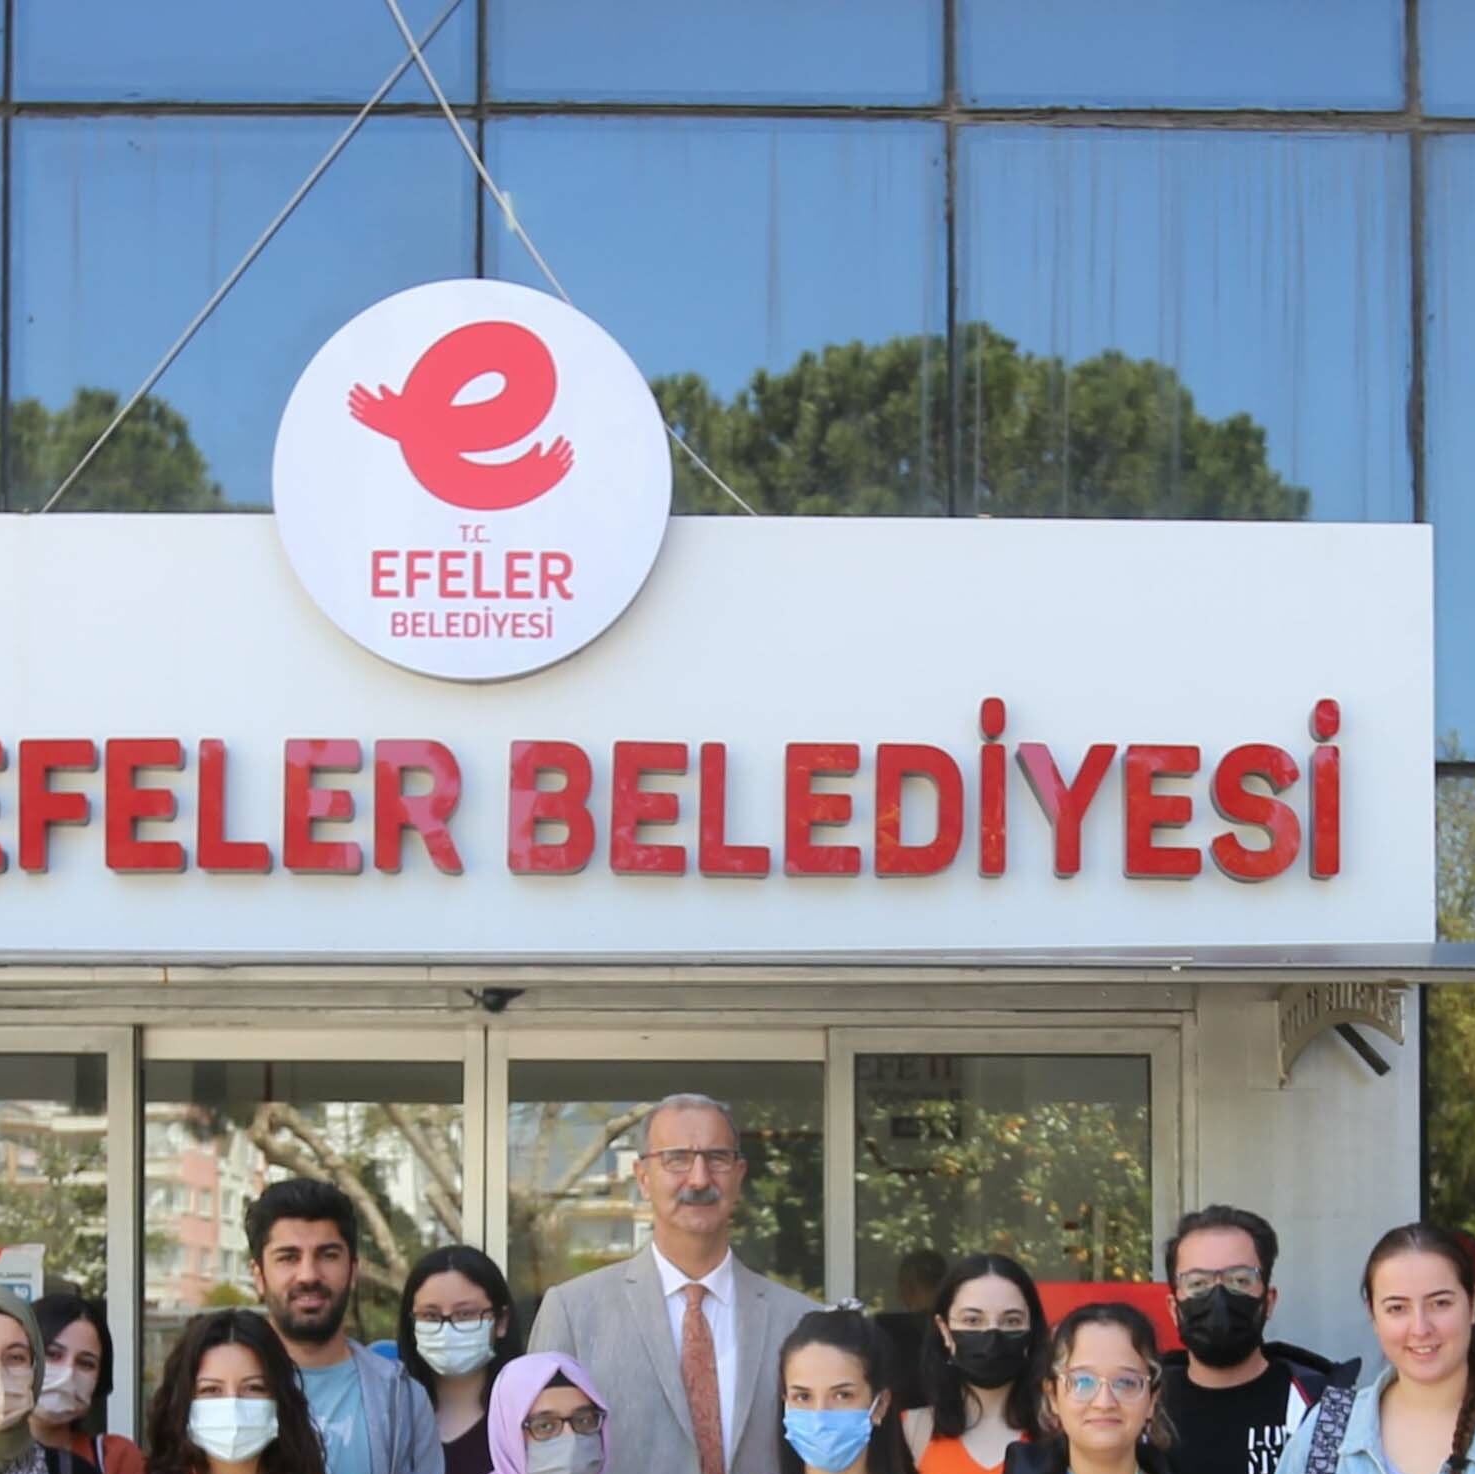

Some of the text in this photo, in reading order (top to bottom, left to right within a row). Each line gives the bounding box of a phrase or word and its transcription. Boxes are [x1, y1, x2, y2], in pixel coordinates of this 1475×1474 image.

[458, 524, 491, 544] T.C.
[371, 550, 574, 601] EFELER
[391, 606, 553, 639] BELEDİYESİ
[508, 697, 1341, 882] BELEDİYESİ
